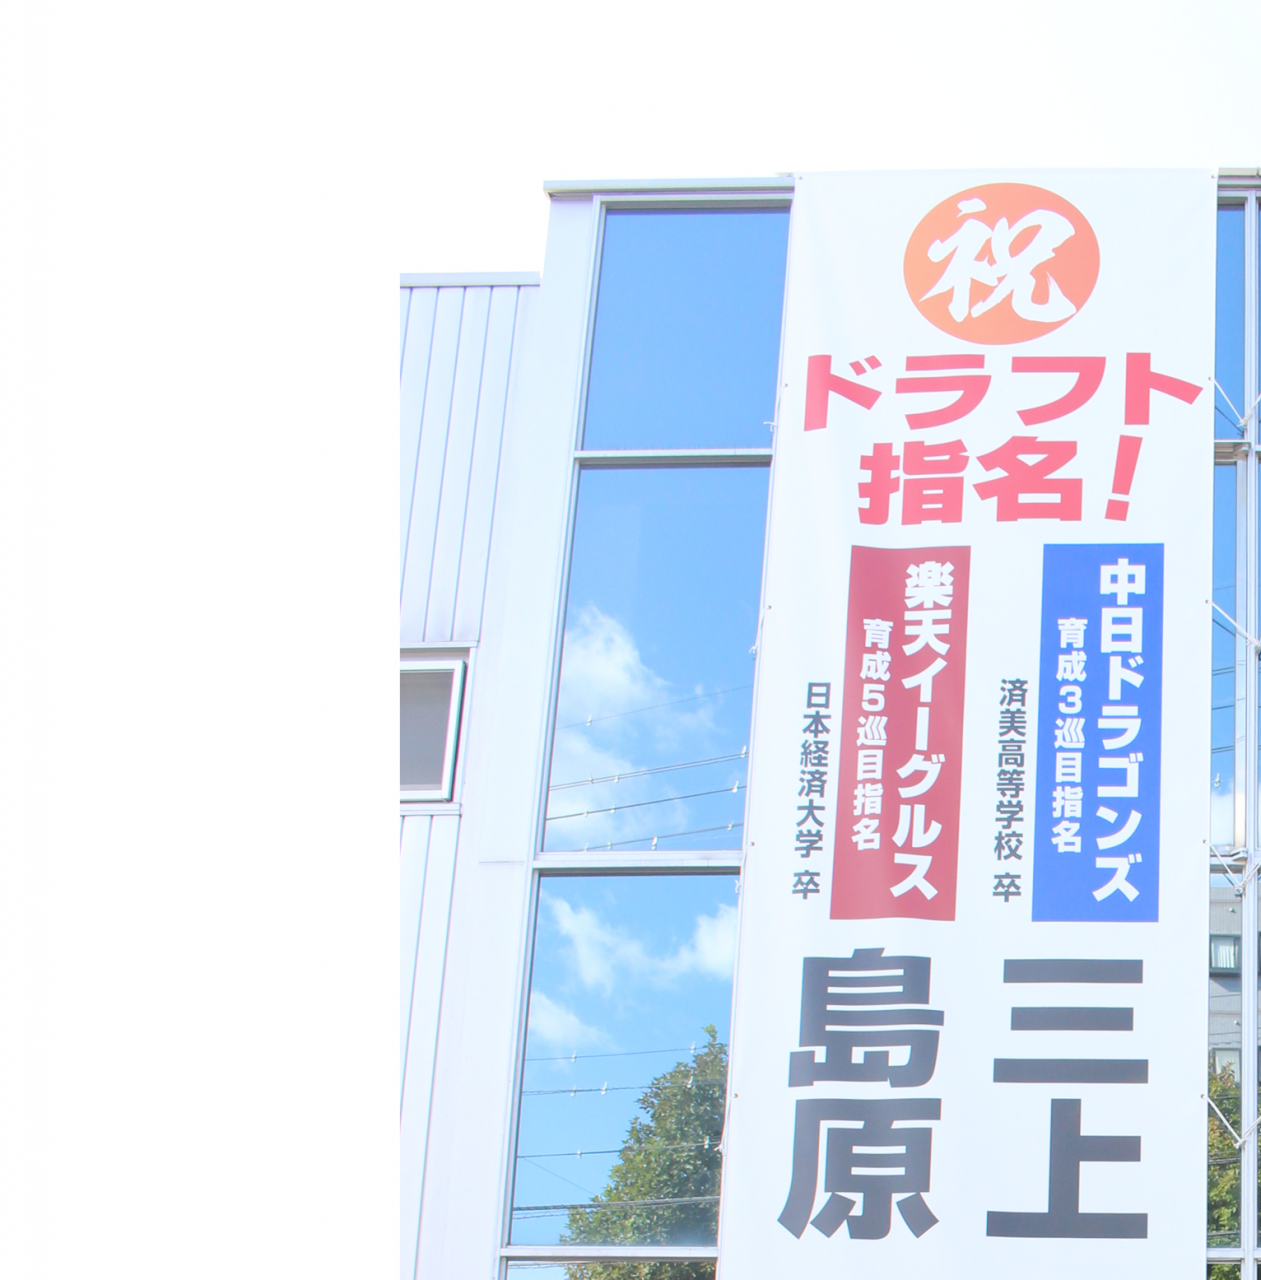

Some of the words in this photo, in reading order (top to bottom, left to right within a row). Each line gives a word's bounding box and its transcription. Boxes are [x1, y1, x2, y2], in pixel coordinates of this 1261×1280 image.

[919, 198, 1077, 322] 祝
[803, 352, 1203, 431] ドラフト
[857, 435, 1143, 525] 指名!
[794, 682, 831, 858] 日本経済大学
[851, 618, 893, 850] 育成5巡目指名
[889, 560, 955, 900] 楽天イーグルス
[994, 678, 1028, 861] 済美高等学校
[1051, 617, 1088, 853] 育成3巡目指名
[1092, 558, 1146, 902] 中日ドラゴンズ
[792, 869, 820, 900] 卒
[992, 872, 1021, 902] 卒
[777, 947, 945, 1240] 島原
[986, 959, 1149, 1239] 三上
